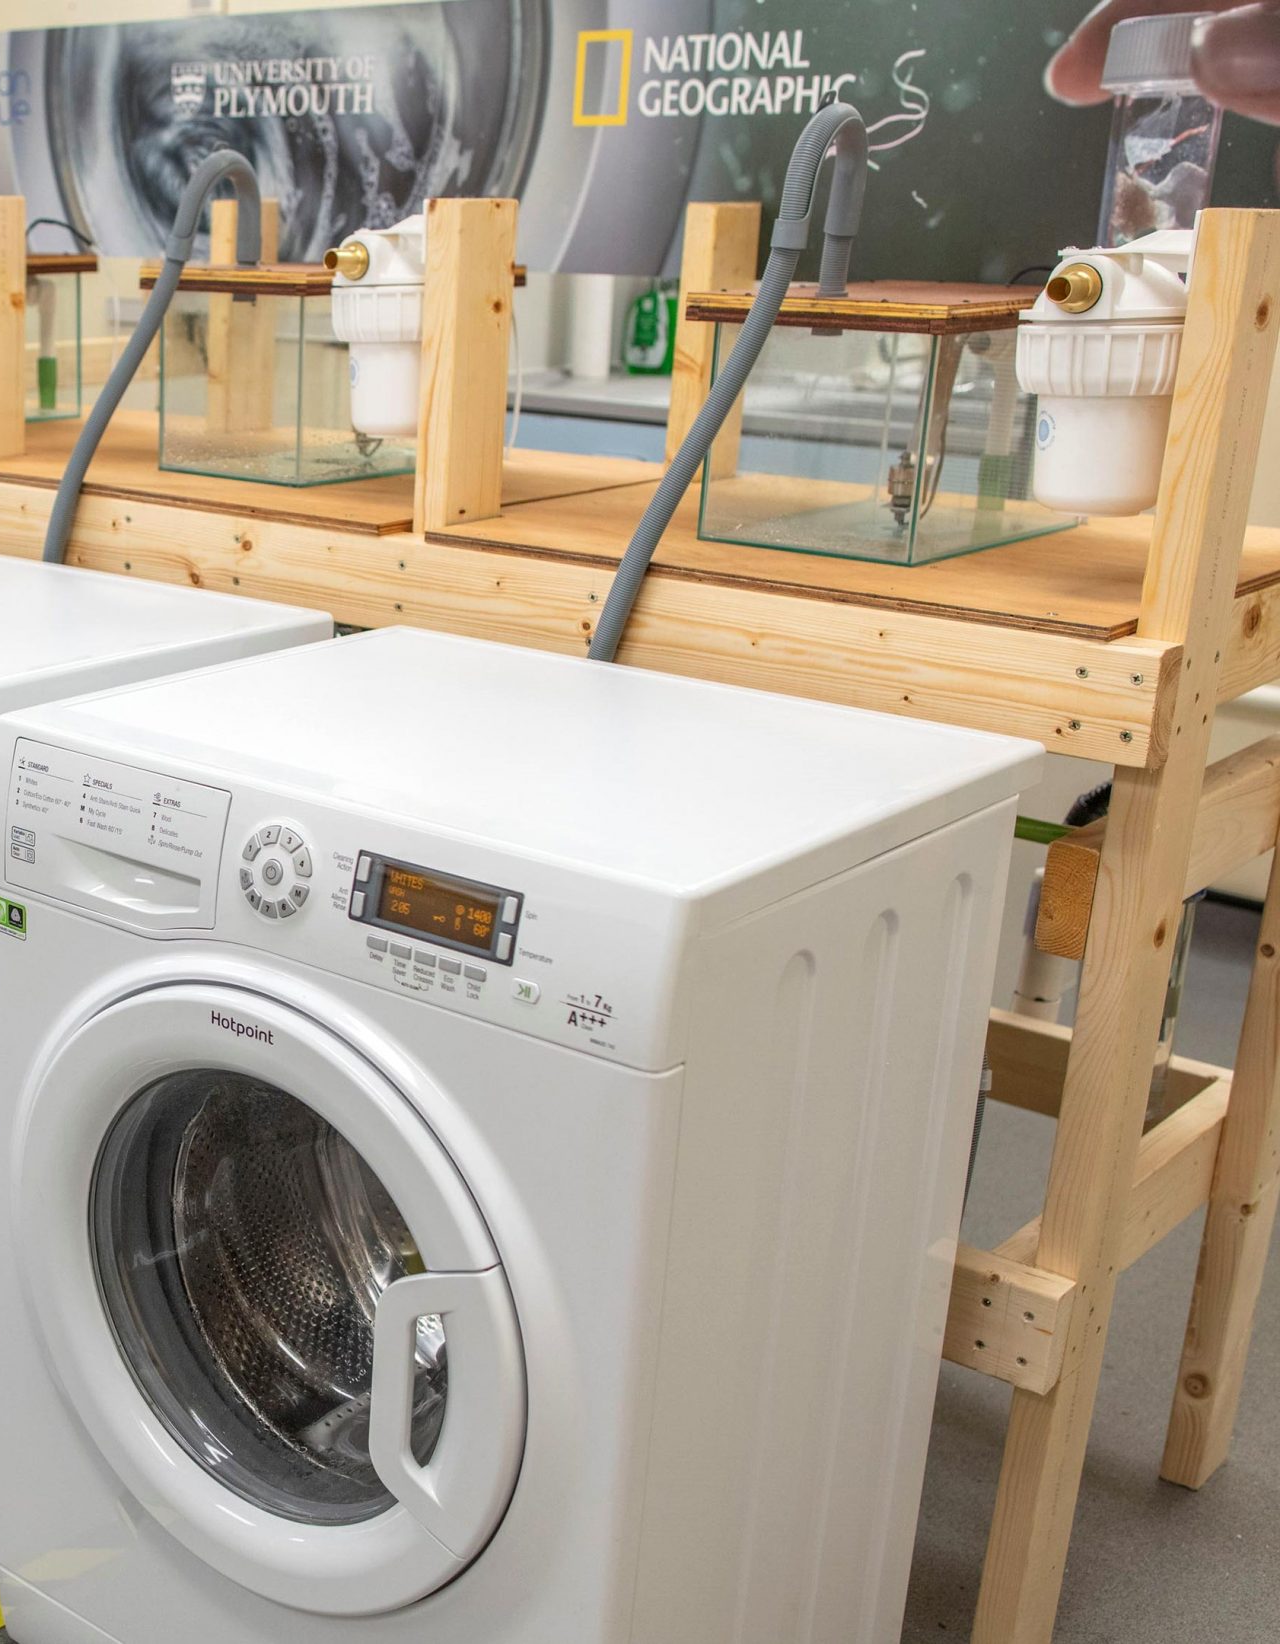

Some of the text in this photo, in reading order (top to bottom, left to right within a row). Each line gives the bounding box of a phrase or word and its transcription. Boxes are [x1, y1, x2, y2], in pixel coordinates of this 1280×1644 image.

[644, 30, 810, 74] NATIONAL
[213, 55, 375, 84] UNIVERSITY OF
[214, 83, 373, 118] PLYMOUTH
[92, 779, 112, 789] SPECIALS
[164, 798, 181, 808] EXTRAS
[391, 870, 423, 889] WHITES
[467, 908, 492, 924] 1400
[525, 910, 538, 920] Spin
[370, 952, 383, 962] Delay
[520, 948, 553, 964] Temperature
[394, 959, 406, 968] Time
[413, 965, 435, 978] Reduced
[444, 975, 453, 983] Eco
[441, 983, 455, 992] Wash
[467, 982, 481, 992] Child
[467, 991, 479, 1000] Lock
[595, 994, 602, 1008] 7
[568, 1010, 607, 1027] A+++
[211, 1010, 274, 1045] Hotpoint
